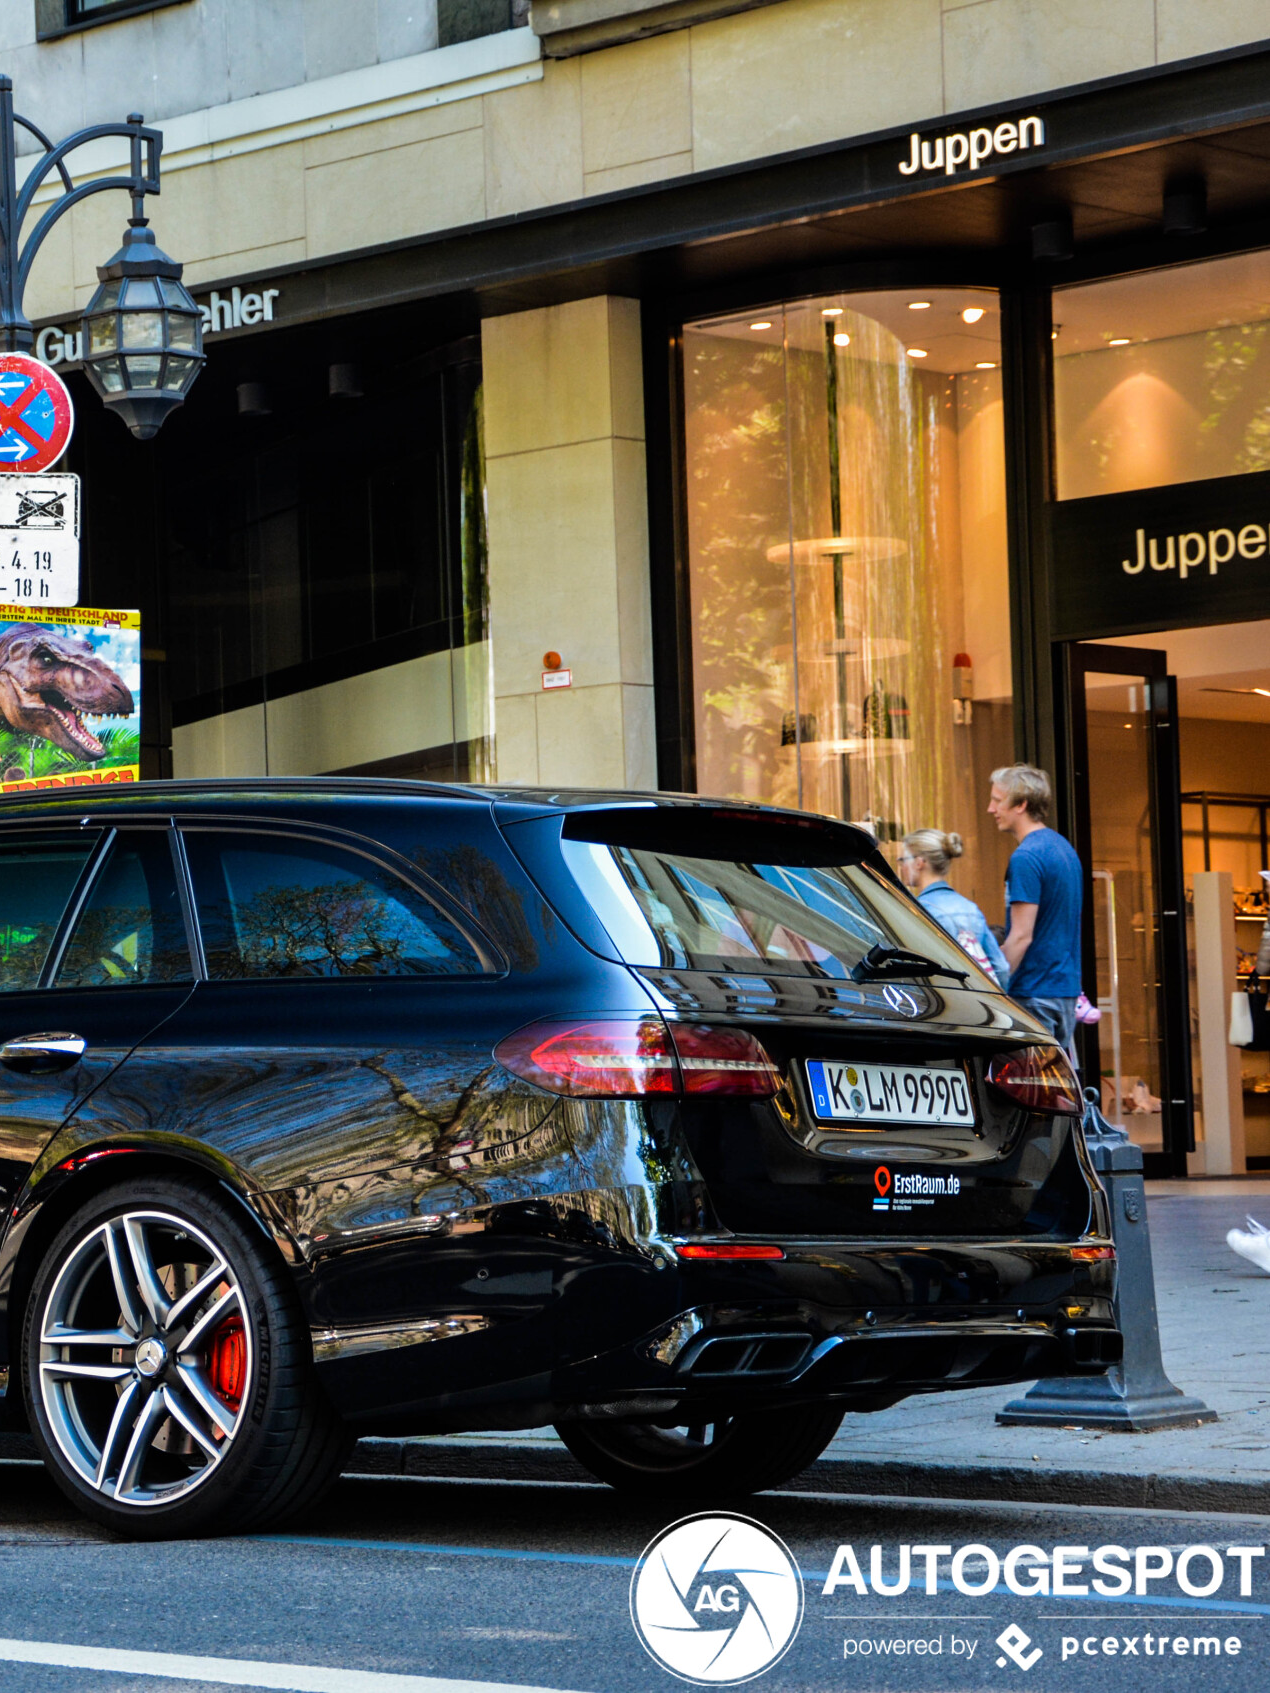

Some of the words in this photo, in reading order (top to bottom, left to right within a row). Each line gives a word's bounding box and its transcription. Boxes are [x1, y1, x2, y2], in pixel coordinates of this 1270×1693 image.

[898, 116, 1045, 175] Juppen
[197, 286, 280, 335] ehler
[1122, 523, 1270, 579] Juppe
[14, 578, 33, 597] 18
[40, 579, 50, 598] h
[30, 606, 43, 615] IN
[47, 606, 129, 622] DEUTSCHLAND
[827, 1067, 851, 1110] K
[862, 1070, 903, 1113] LM
[903, 1073, 969, 1117] 9990
[893, 1174, 961, 1195] ErstRaum.de
[252, 1322, 271, 1424] MICHELIN
